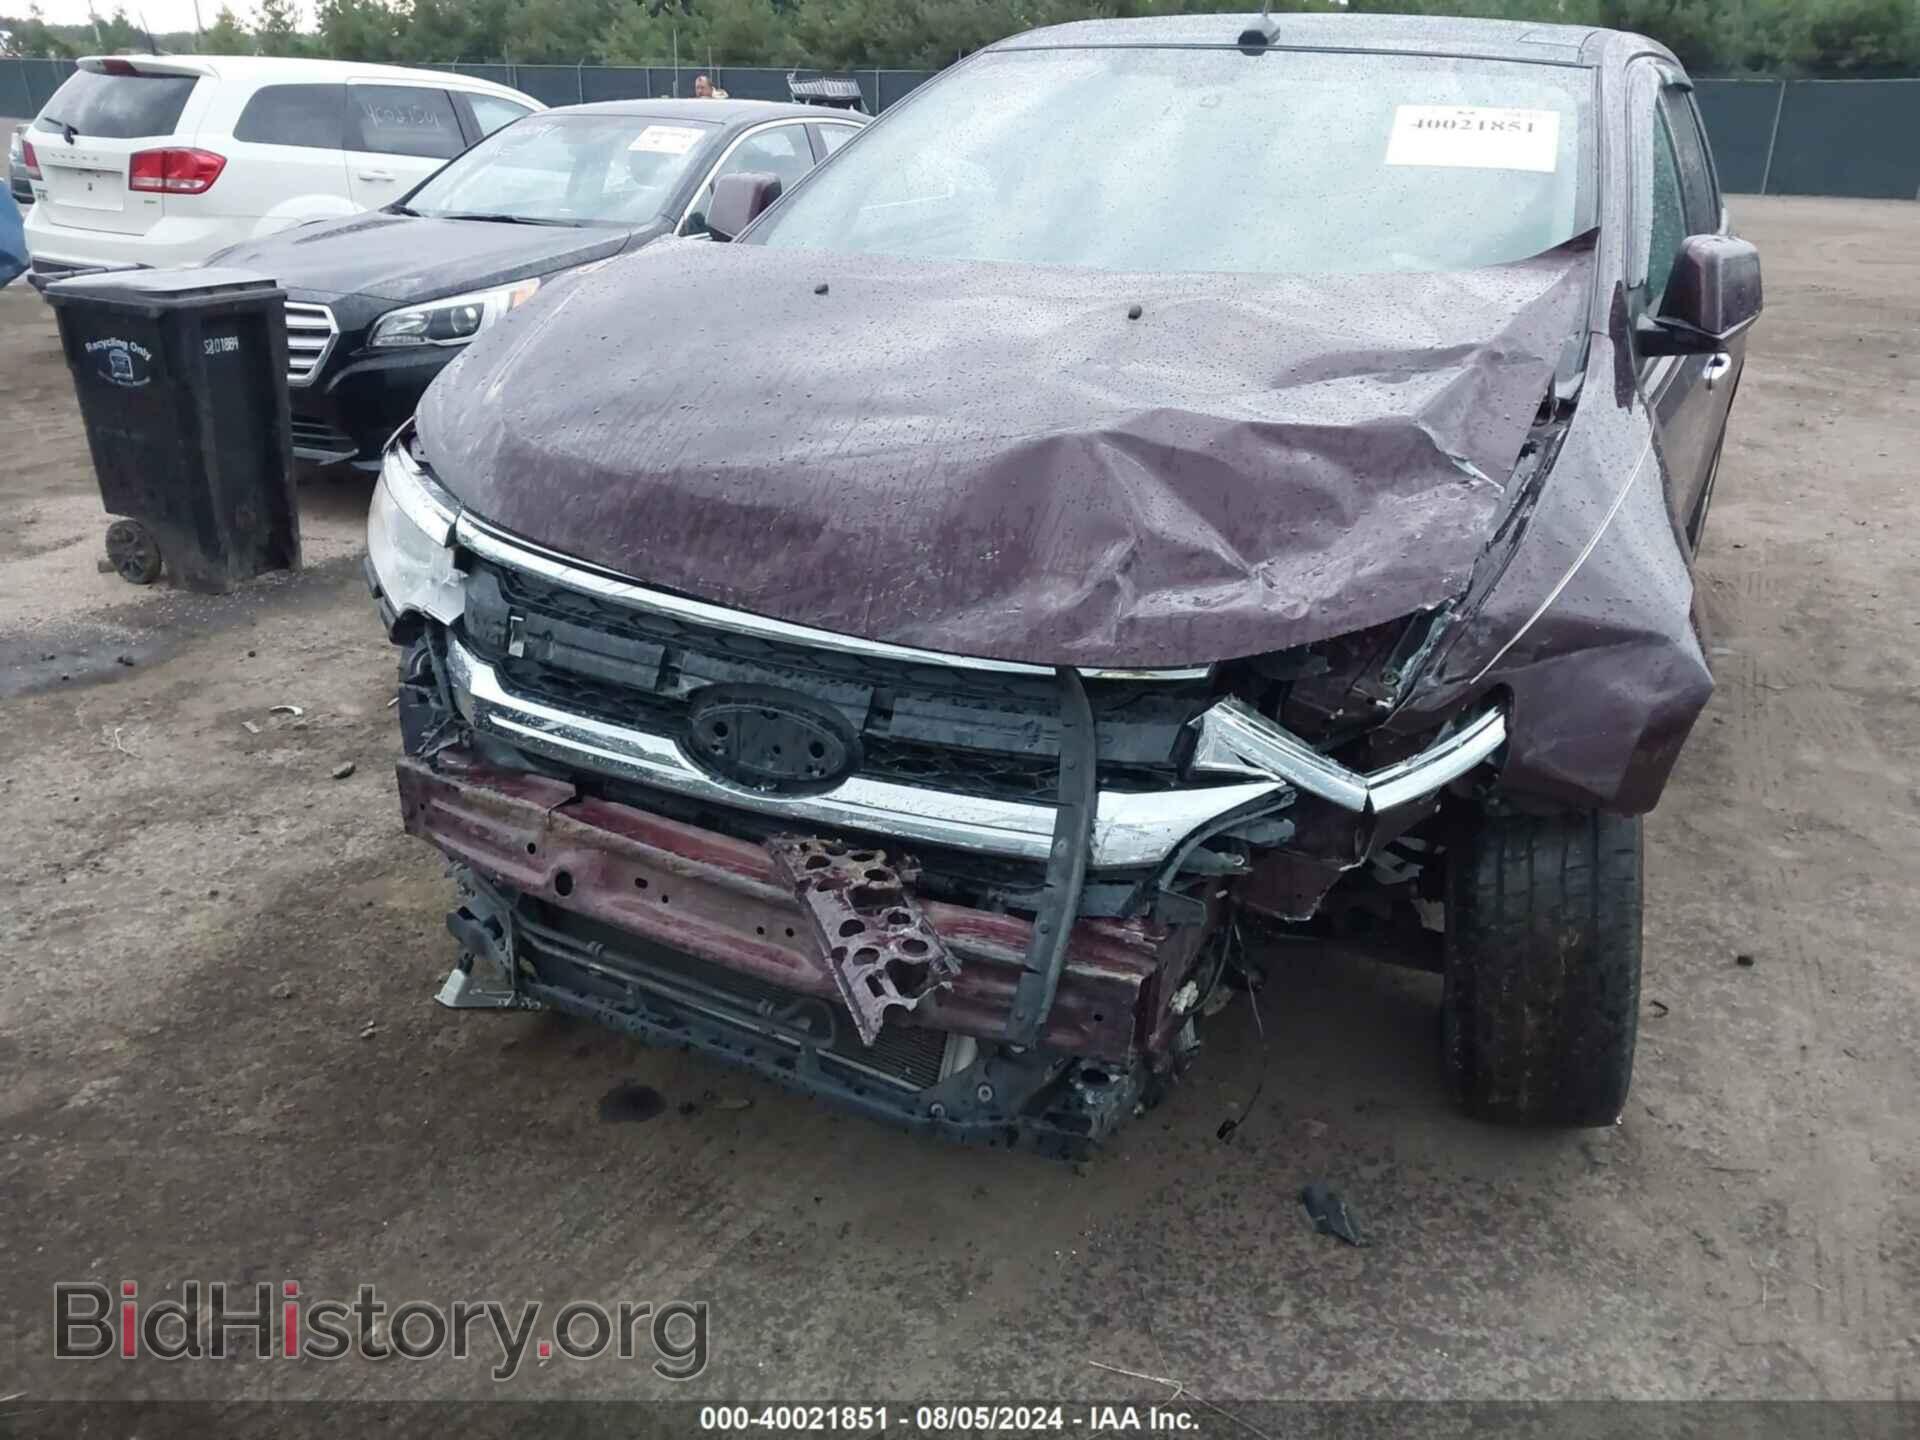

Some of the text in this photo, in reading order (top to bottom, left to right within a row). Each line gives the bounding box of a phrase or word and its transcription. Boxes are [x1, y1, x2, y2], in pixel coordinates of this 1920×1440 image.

[1411, 118, 1535, 133] 40021851
[85, 337, 152, 361] Recycling Only
